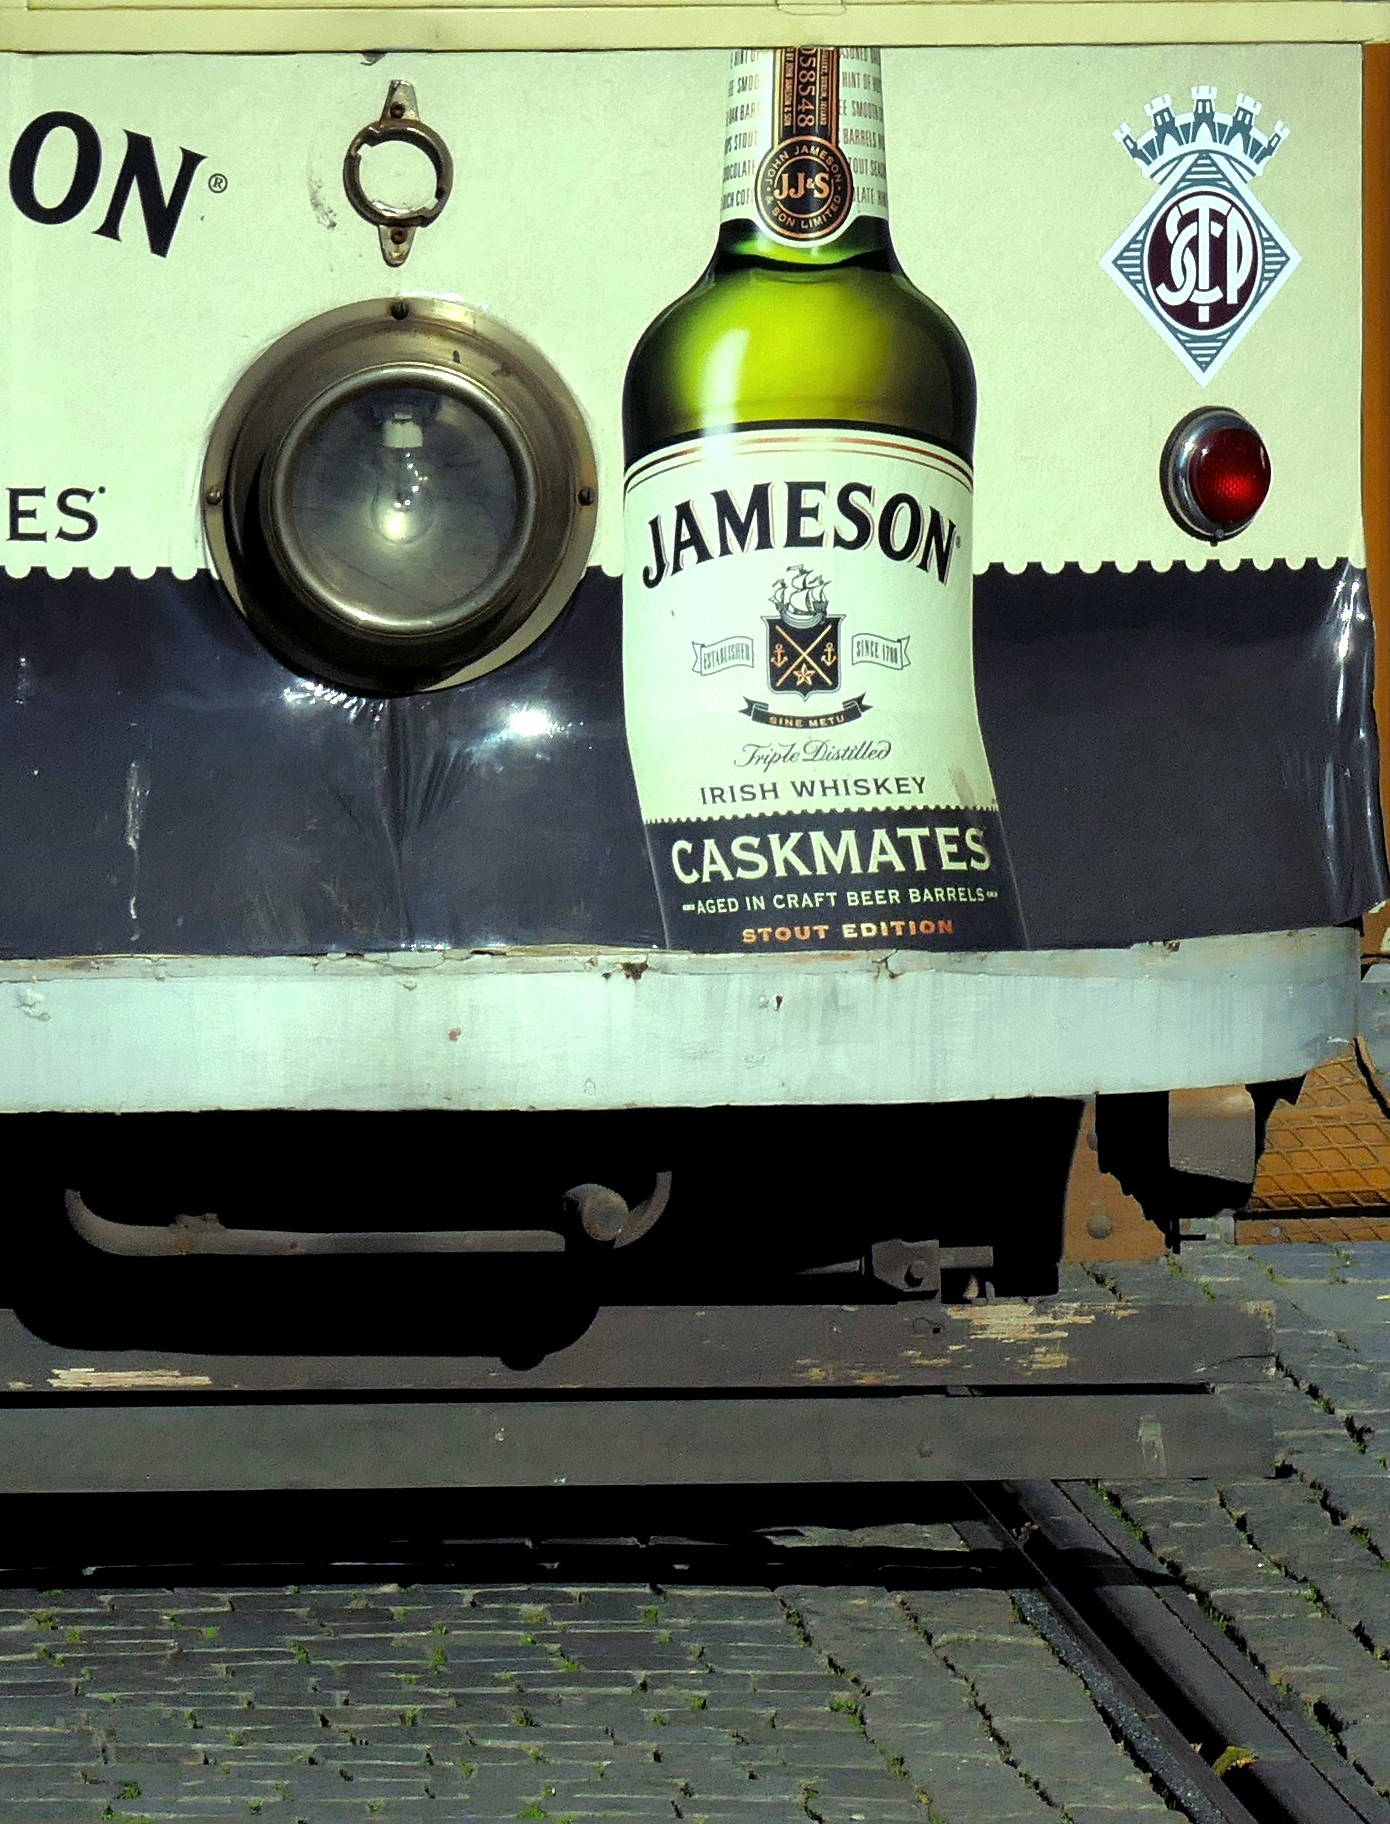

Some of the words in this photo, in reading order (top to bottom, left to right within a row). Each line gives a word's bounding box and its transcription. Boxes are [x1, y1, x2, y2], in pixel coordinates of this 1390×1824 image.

[794, 145, 841, 183] JAMESON
[642, 481, 957, 589] JAMESON
[769, 716, 803, 728] SINE
[808, 715, 846, 728] METU
[733, 742, 801, 773] Triple
[802, 739, 892, 763] Distilled
[700, 781, 780, 805] IRISH
[790, 776, 927, 798] WHISKEY
[671, 826, 991, 884] CASKMATES
[697, 897, 739, 915] AGED
[746, 896, 766, 911] IN
[772, 891, 838, 909] CRAFT
[847, 889, 901, 906] BEER
[909, 887, 985, 904] BARRELS
[742, 925, 830, 943] STOUT
[842, 919, 956, 939] EDITION
